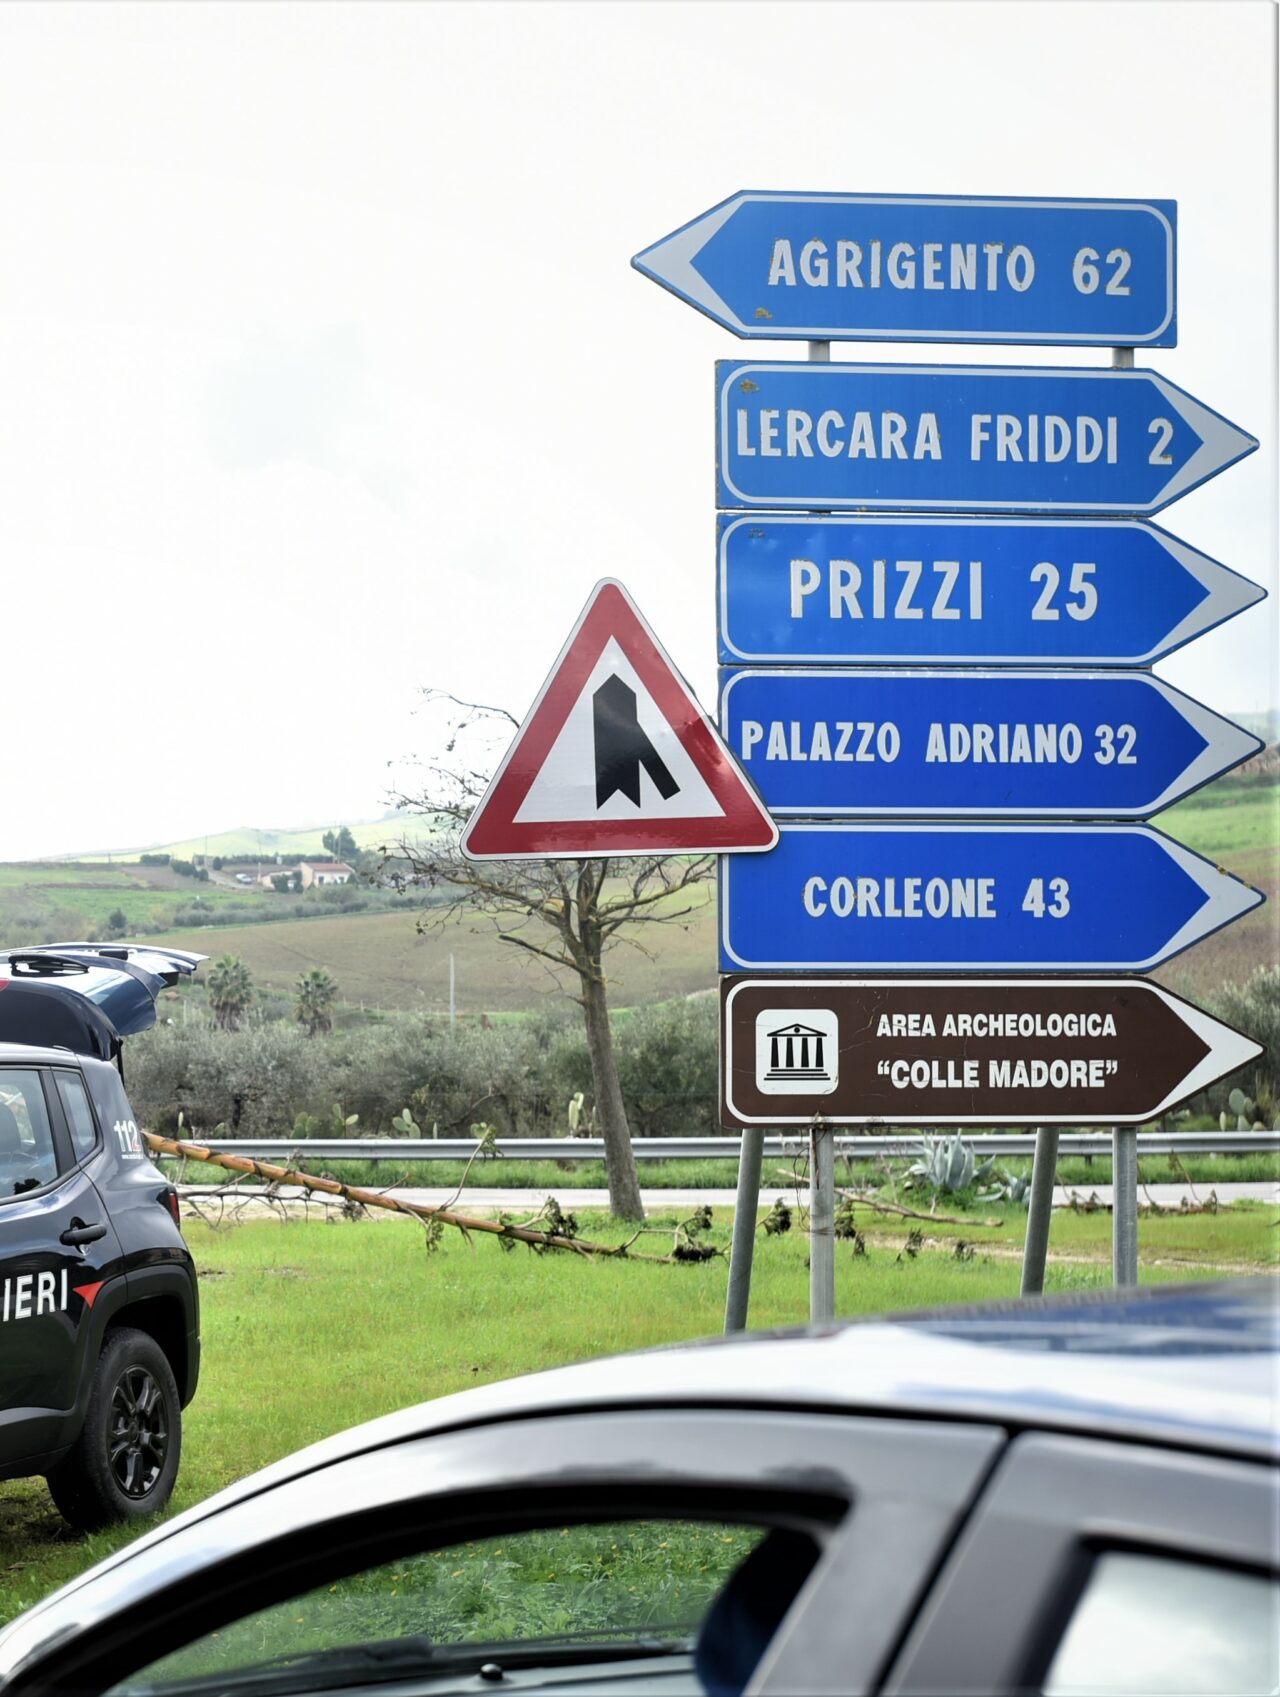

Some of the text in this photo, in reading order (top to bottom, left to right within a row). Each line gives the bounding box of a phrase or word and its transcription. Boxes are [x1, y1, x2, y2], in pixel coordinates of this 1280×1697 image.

[767, 237, 1132, 296] AGRIGENTO 62
[736, 408, 1175, 465] LERCARA FRIDDI 2
[789, 558, 1098, 621] PRIZZI 25
[741, 720, 1138, 765] PALAZZO ADRIANO 32
[803, 876, 1071, 919] CORLEONE 43
[876, 1013, 1117, 1038] AREA ARCHEOLOGICA
[877, 1059, 1118, 1089] “COLLE MADORE”
[113, 1120, 141, 1152] 112
